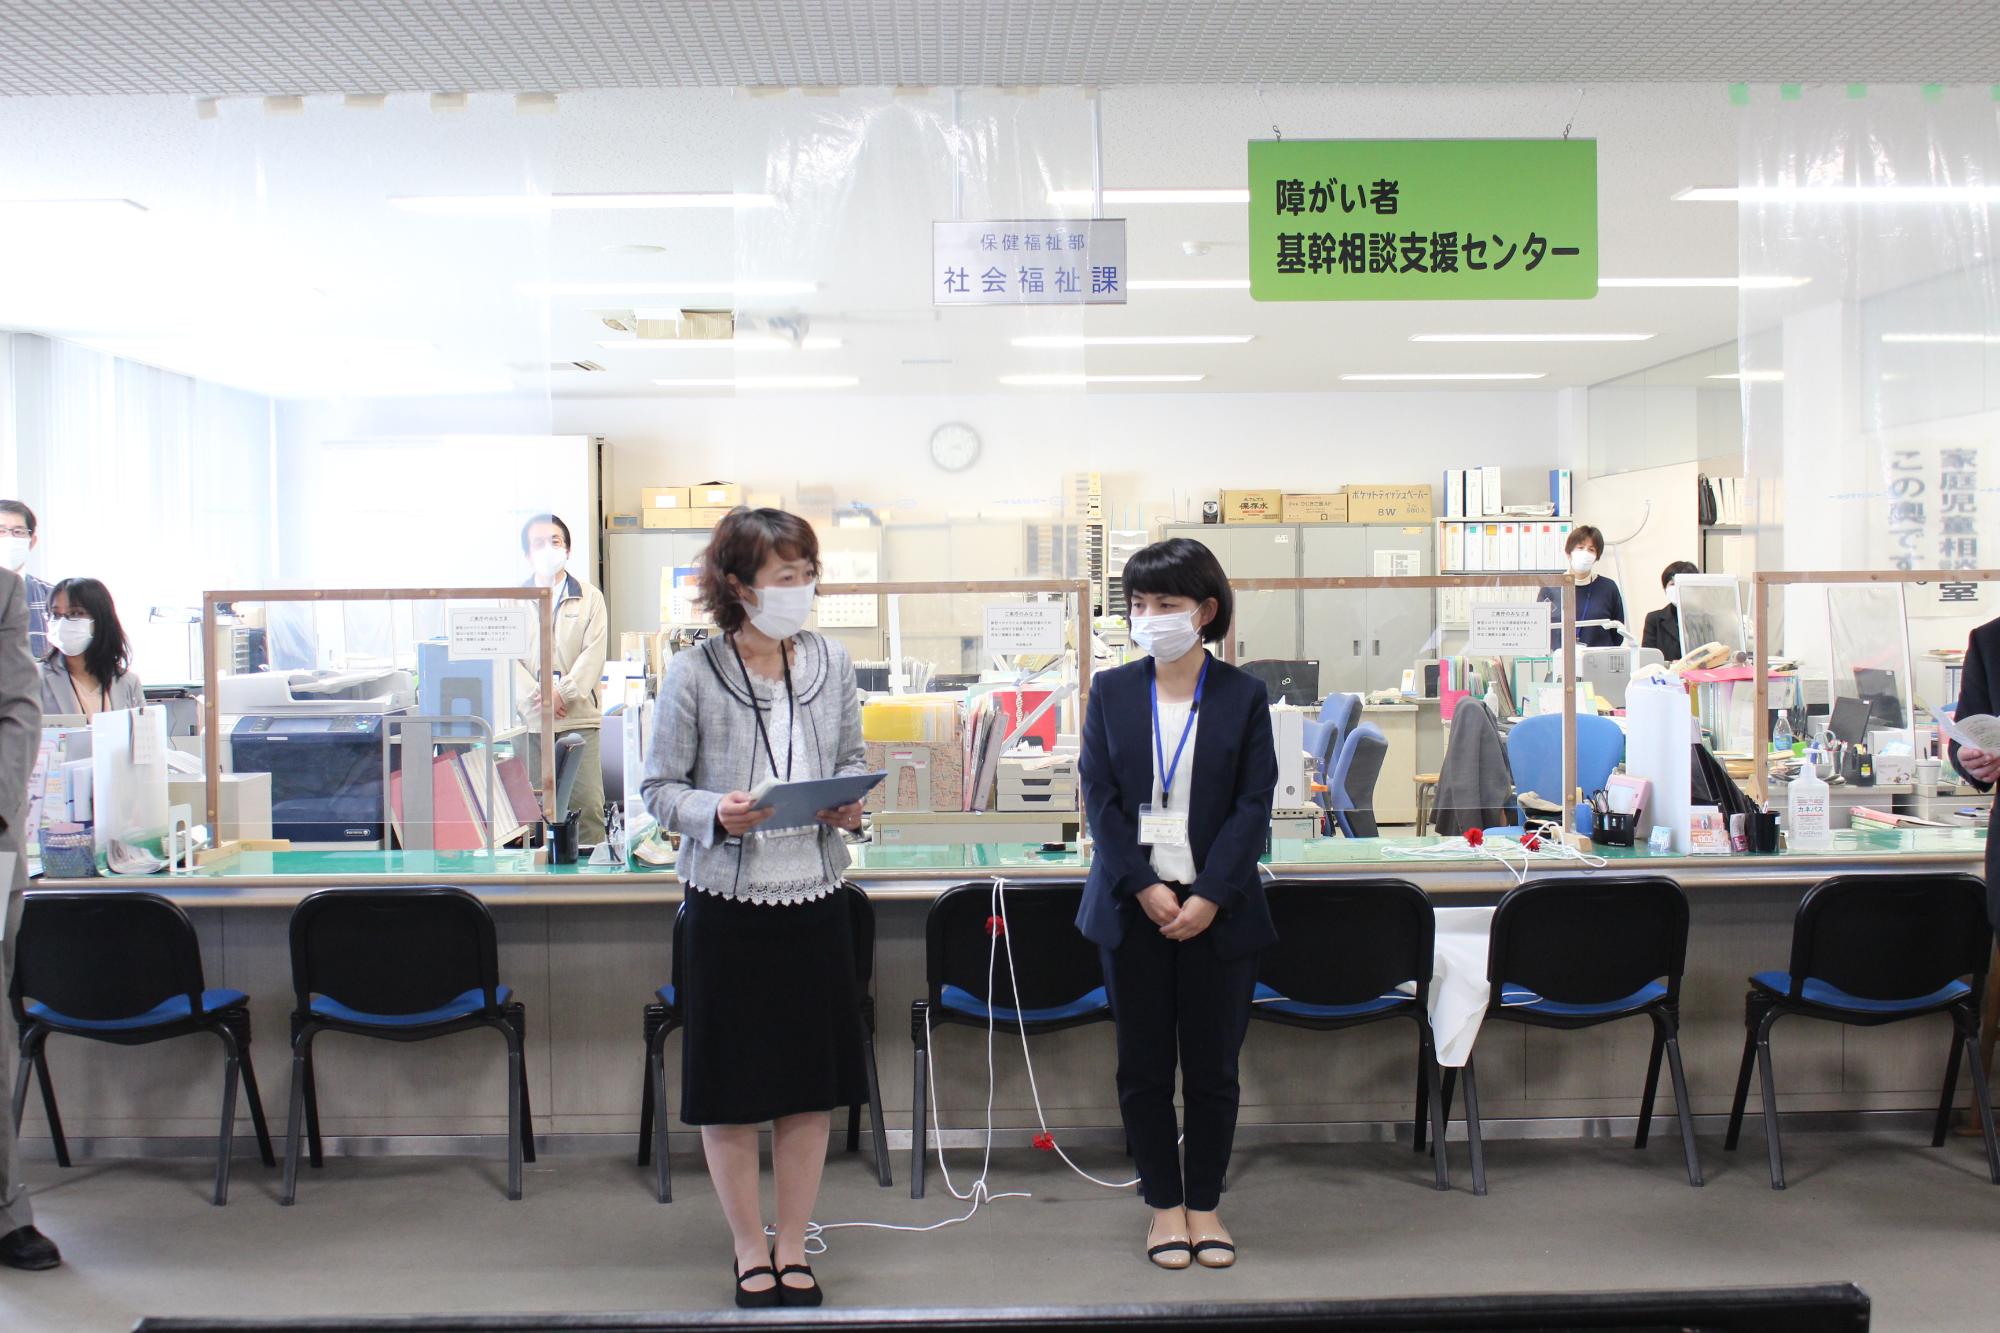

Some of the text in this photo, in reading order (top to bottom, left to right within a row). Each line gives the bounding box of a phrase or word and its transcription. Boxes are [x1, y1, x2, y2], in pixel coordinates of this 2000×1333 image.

[1275, 177, 1400, 217] 障がい者
[979, 232, 1087, 252] 保健福祉部
[1275, 230, 1581, 275] 基幹相談支援センター
[943, 265, 1120, 295] 社会福祉課
[1239, 501, 1269, 510] 保存水
